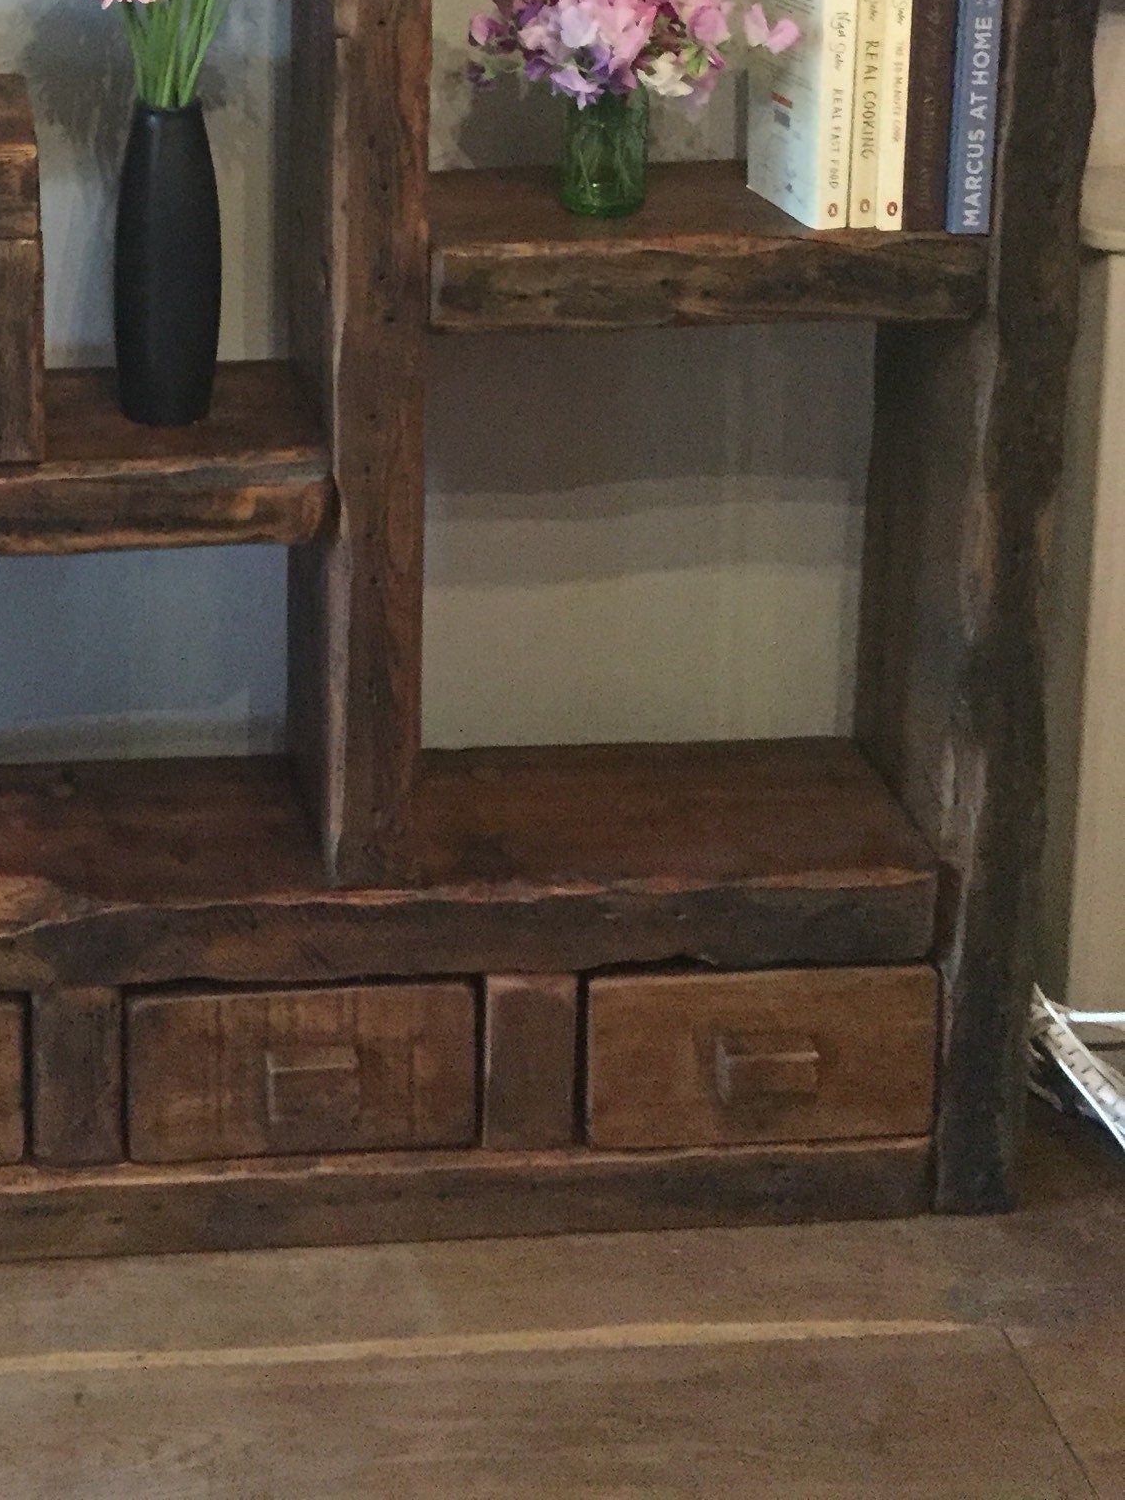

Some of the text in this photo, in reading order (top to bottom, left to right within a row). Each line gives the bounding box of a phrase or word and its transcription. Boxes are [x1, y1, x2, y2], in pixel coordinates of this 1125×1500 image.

[828, 88, 843, 189] REAL FAST FOOD
[857, 40, 879, 159] REAL COOKING
[962, 17, 992, 227] MARCUS AT HOME
